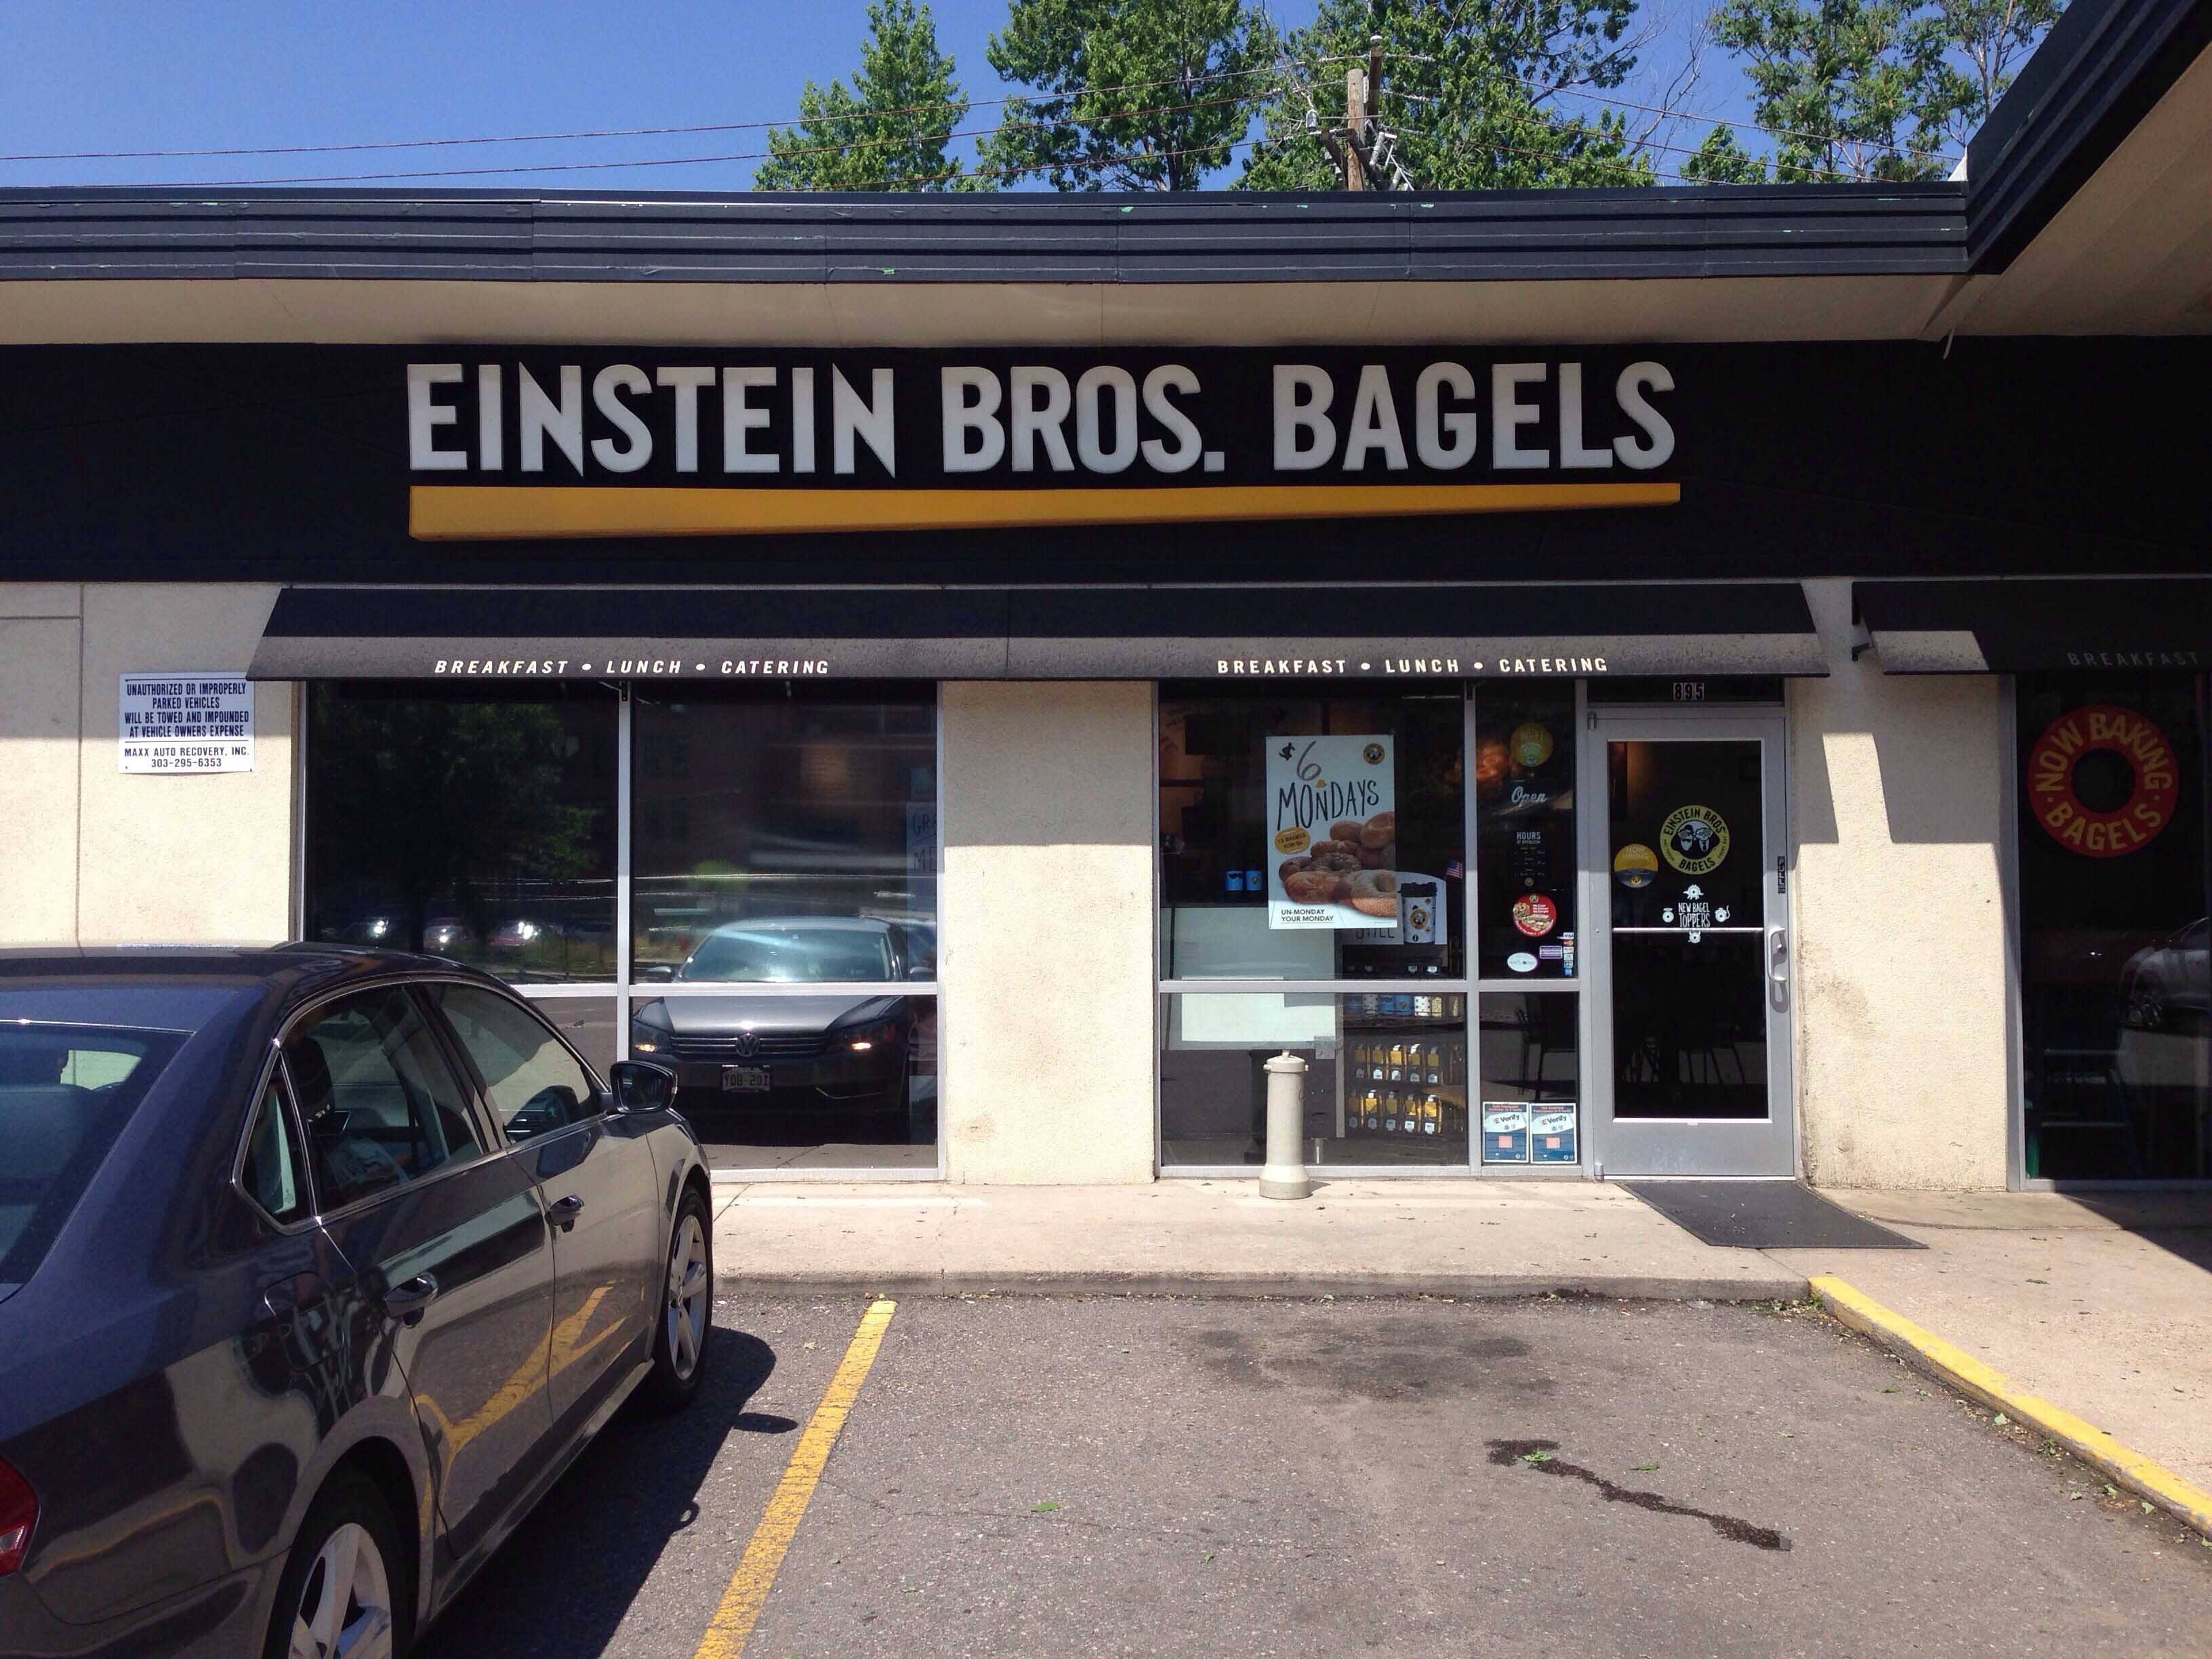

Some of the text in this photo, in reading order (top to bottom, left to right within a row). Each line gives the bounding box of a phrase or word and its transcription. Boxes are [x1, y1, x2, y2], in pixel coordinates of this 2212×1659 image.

[407, 361, 1677, 478] EINSTEIN BROS. BAGELS
[1217, 657, 1608, 674] BREAKFAST LUNCH CATERING
[2066, 651, 2200, 666] BREAKFAST
[434, 659, 830, 674] BREAKFAST LUNCH CATERING
[127, 682, 246, 695] UNAUTHORIZED OR IMPROPERLY
[1675, 683, 1703, 699] 895
[152, 697, 220, 709] PARKED VEHICLES
[125, 710, 249, 724] WILL BE TOWED AND IMPOUNDED
[129, 724, 244, 737] AT VEHICLE OWNERS EXPENSE
[124, 746, 249, 757] MAXX AUTO RECOVERY, INC.
[2034, 712, 2173, 792] NOW BAKING
[151, 758, 222, 768] 303-295-6353
[1511, 785, 1547, 808] Open
[1663, 807, 1700, 836] EINSTEIN
[2045, 802, 2162, 851] BAGELS
[1517, 832, 1541, 840] HOURS
[1679, 857, 1715, 872] BAGELS
[1678, 902, 1711, 912] NEW BAGEL
[1679, 913, 1711, 928] TOPPERS
